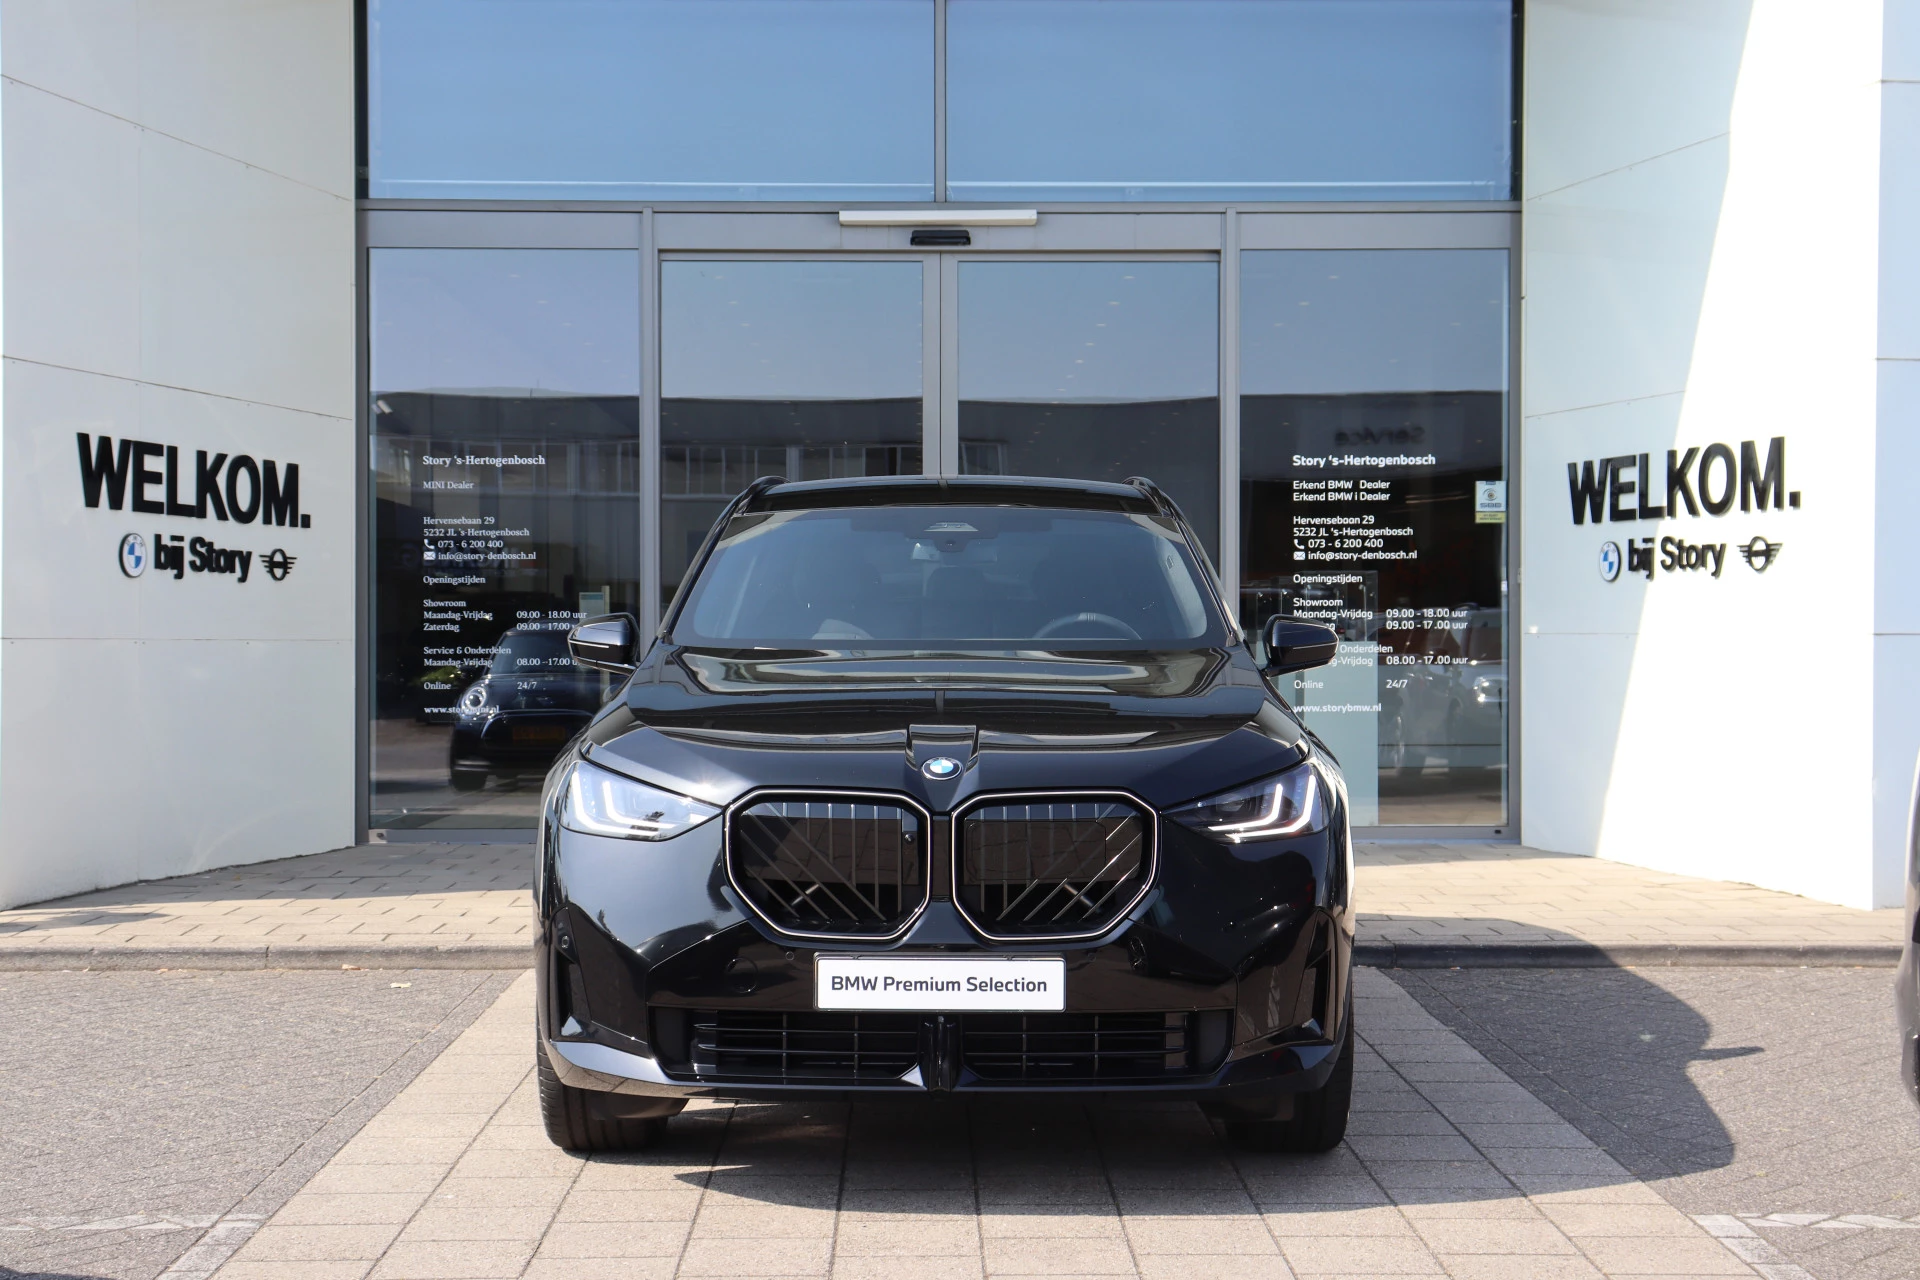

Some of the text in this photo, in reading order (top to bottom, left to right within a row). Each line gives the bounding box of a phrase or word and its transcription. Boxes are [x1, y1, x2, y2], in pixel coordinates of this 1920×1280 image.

[423, 456, 451, 467] Story
[1293, 455, 1326, 468] Story
[77, 432, 310, 528] WELKOM.
[1293, 480, 1390, 489] Erkend BMW Dealer
[1567, 436, 1801, 525] WELKOM.
[423, 481, 474, 489] MINI Dealer
[1293, 492, 1390, 501] Erkend BMW i Dealer
[423, 517, 481, 525] Hervensebaan
[1293, 516, 1374, 525] Hervensebaan 29
[424, 529, 444, 537] 5232
[447, 529, 456, 537] JL
[1293, 527, 1316, 536] 5232
[1318, 527, 1328, 536] JL
[438, 540, 454, 548] 073
[461, 540, 467, 548] 6
[469, 540, 485, 548] 200
[487, 540, 503, 548] 400
[1308, 539, 1326, 548] 073
[1335, 539, 1341, 548] 6
[1343, 539, 1362, 548] 200
[1364, 539, 1383, 548] 400
[154, 534, 252, 583] bij Story
[438, 552, 536, 561] info@story-denbosch.nl
[1308, 551, 1417, 561] info@story-denbosch.nl
[1628, 536, 1726, 581] bij Story
[423, 576, 486, 585] Openingstijden
[1293, 574, 1362, 585] Openingstijden
[424, 599, 466, 607] Showroom
[1293, 598, 1343, 607] Showroom
[424, 611, 493, 620] Maandag-Vrijdag
[517, 611, 540, 619] 09.00
[548, 611, 570, 619] 18.00
[1293, 609, 1373, 620] Maandag-Vrijdag
[1386, 609, 1414, 617] 09.00
[1423, 609, 1449, 617] 18.00
[424, 623, 459, 632] Zaterdag
[517, 623, 540, 631] 09.00
[548, 623, 570, 631] 17.00
[1386, 621, 1414, 630] 09.00
[1453, 622, 1468, 630] uur
[424, 646, 454, 655] Service
[464, 646, 511, 655] Onderdelen
[1340, 644, 1393, 653] Onderdelen
[424, 658, 493, 667] Maandag-Vrijdag
[517, 658, 540, 666] 08.00
[548, 658, 570, 666] 17.00
[1329, 656, 1373, 667] g-Vrijdag
[1386, 656, 1415, 665] 08.00
[1453, 657, 1468, 665] uur
[424, 681, 537, 690] Online 24/7
[1294, 679, 1408, 689] Online 24/7
[1293, 703, 1381, 714] www.storybmw.nl
[832, 976, 1047, 992] BMW Premium Selection
